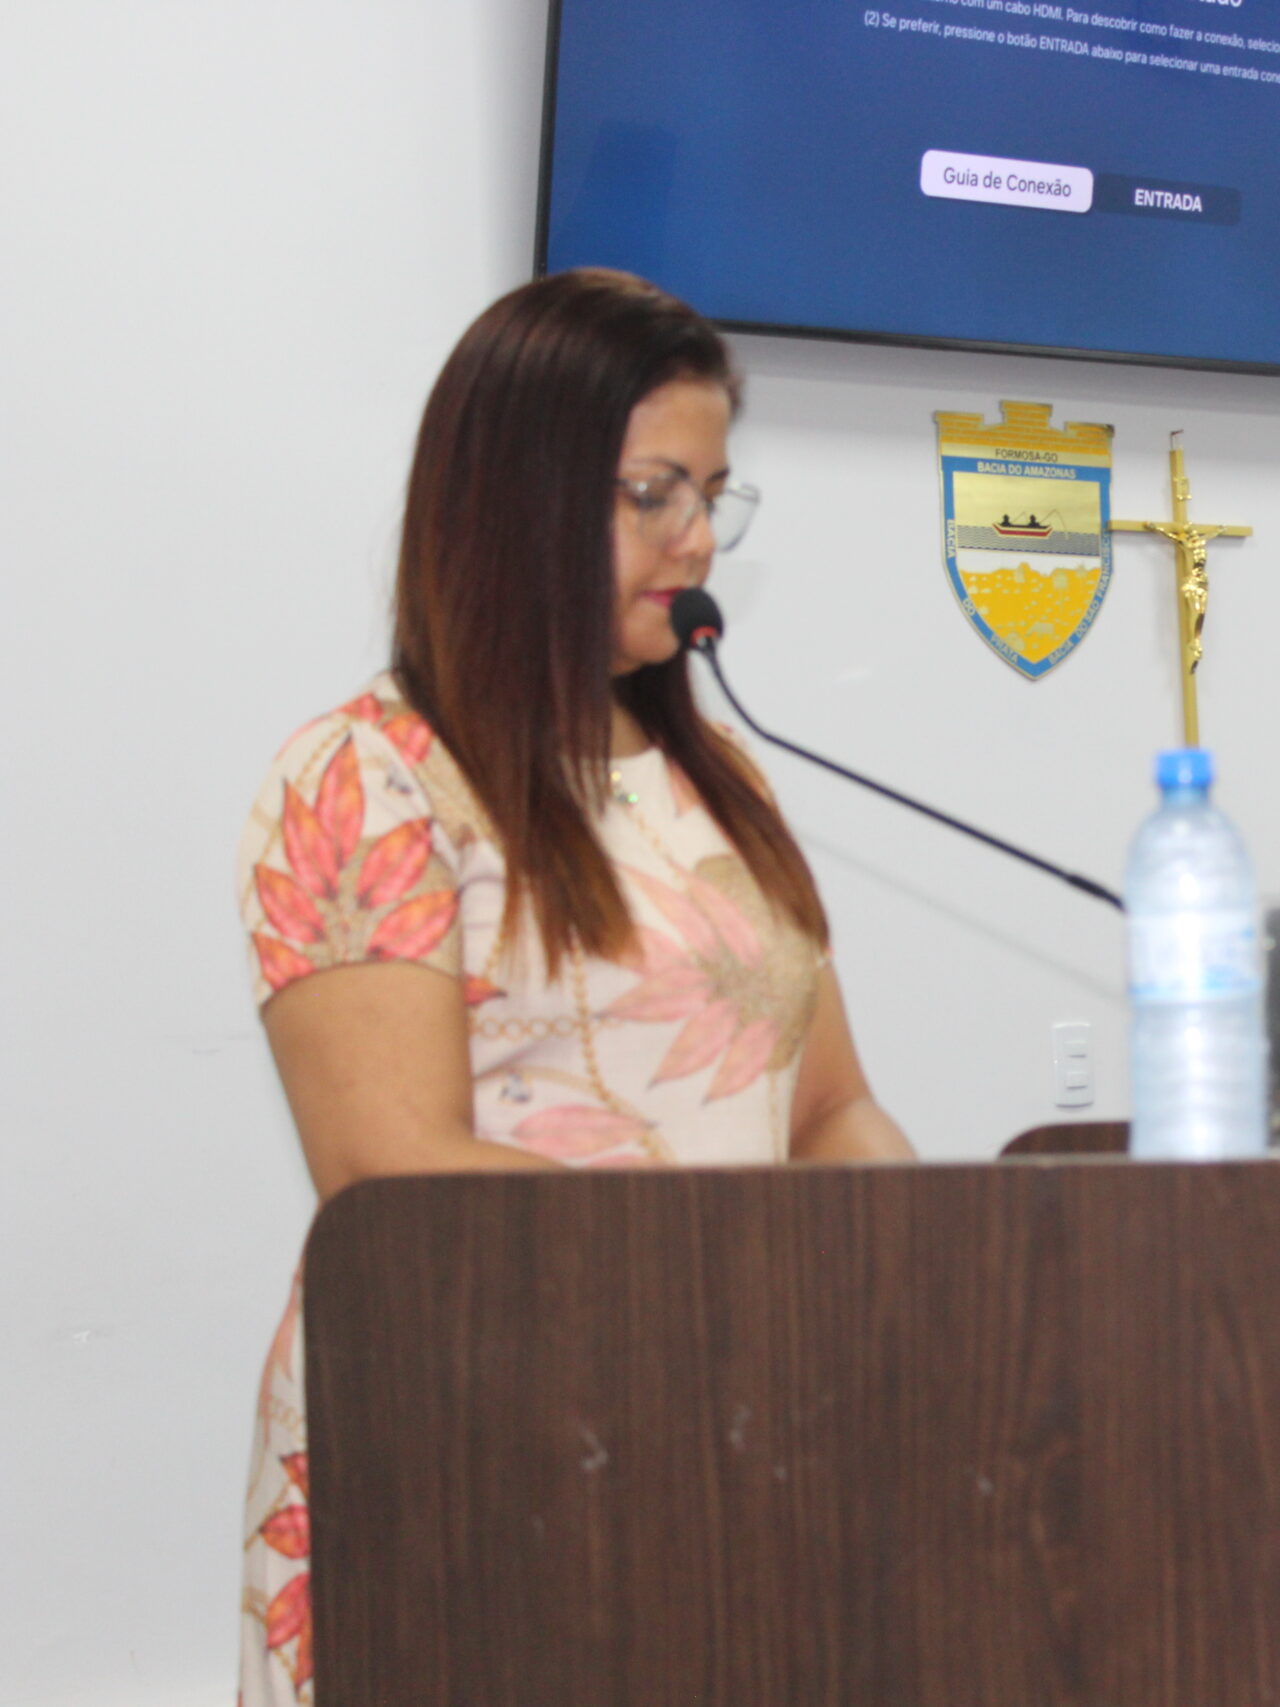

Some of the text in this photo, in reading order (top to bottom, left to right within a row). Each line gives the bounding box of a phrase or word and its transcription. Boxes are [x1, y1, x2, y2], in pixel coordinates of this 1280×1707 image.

[986, 1, 1002, 11] um
[1005, 2, 1031, 15] cabo
[1033, 3, 1063, 20] HDMI.
[1066, 8, 1089, 24] Para
[1091, 13, 1138, 31] descobrir
[1139, 21, 1167, 36] como
[1169, 24, 1194, 40] fazer
[1196, 31, 1203, 42] a
[1204, 32, 1246, 49] conexão,
[864, 10, 880, 28] (2)
[882, 13, 896, 28] Se
[899, 17, 942, 36] preferir,
[944, 24, 995, 43] pressione
[997, 33, 1005, 44] o
[1006, 31, 1038, 49] botão
[1039, 36, 1089, 56] ENTRADA
[1091, 44, 1123, 60] abaixo
[1125, 51, 1148, 65] para
[1149, 54, 1199, 71] selecionar
[1200, 62, 1221, 75] uma
[1222, 65, 1259, 80] entrada
[943, 166, 1072, 197] Guia de Conexão
[1134, 188, 1203, 212] ENTRADA
[995, 448, 1059, 462] FORMOSA-GO
[977, 461, 1076, 480] BACIA DO AMAZONAS
